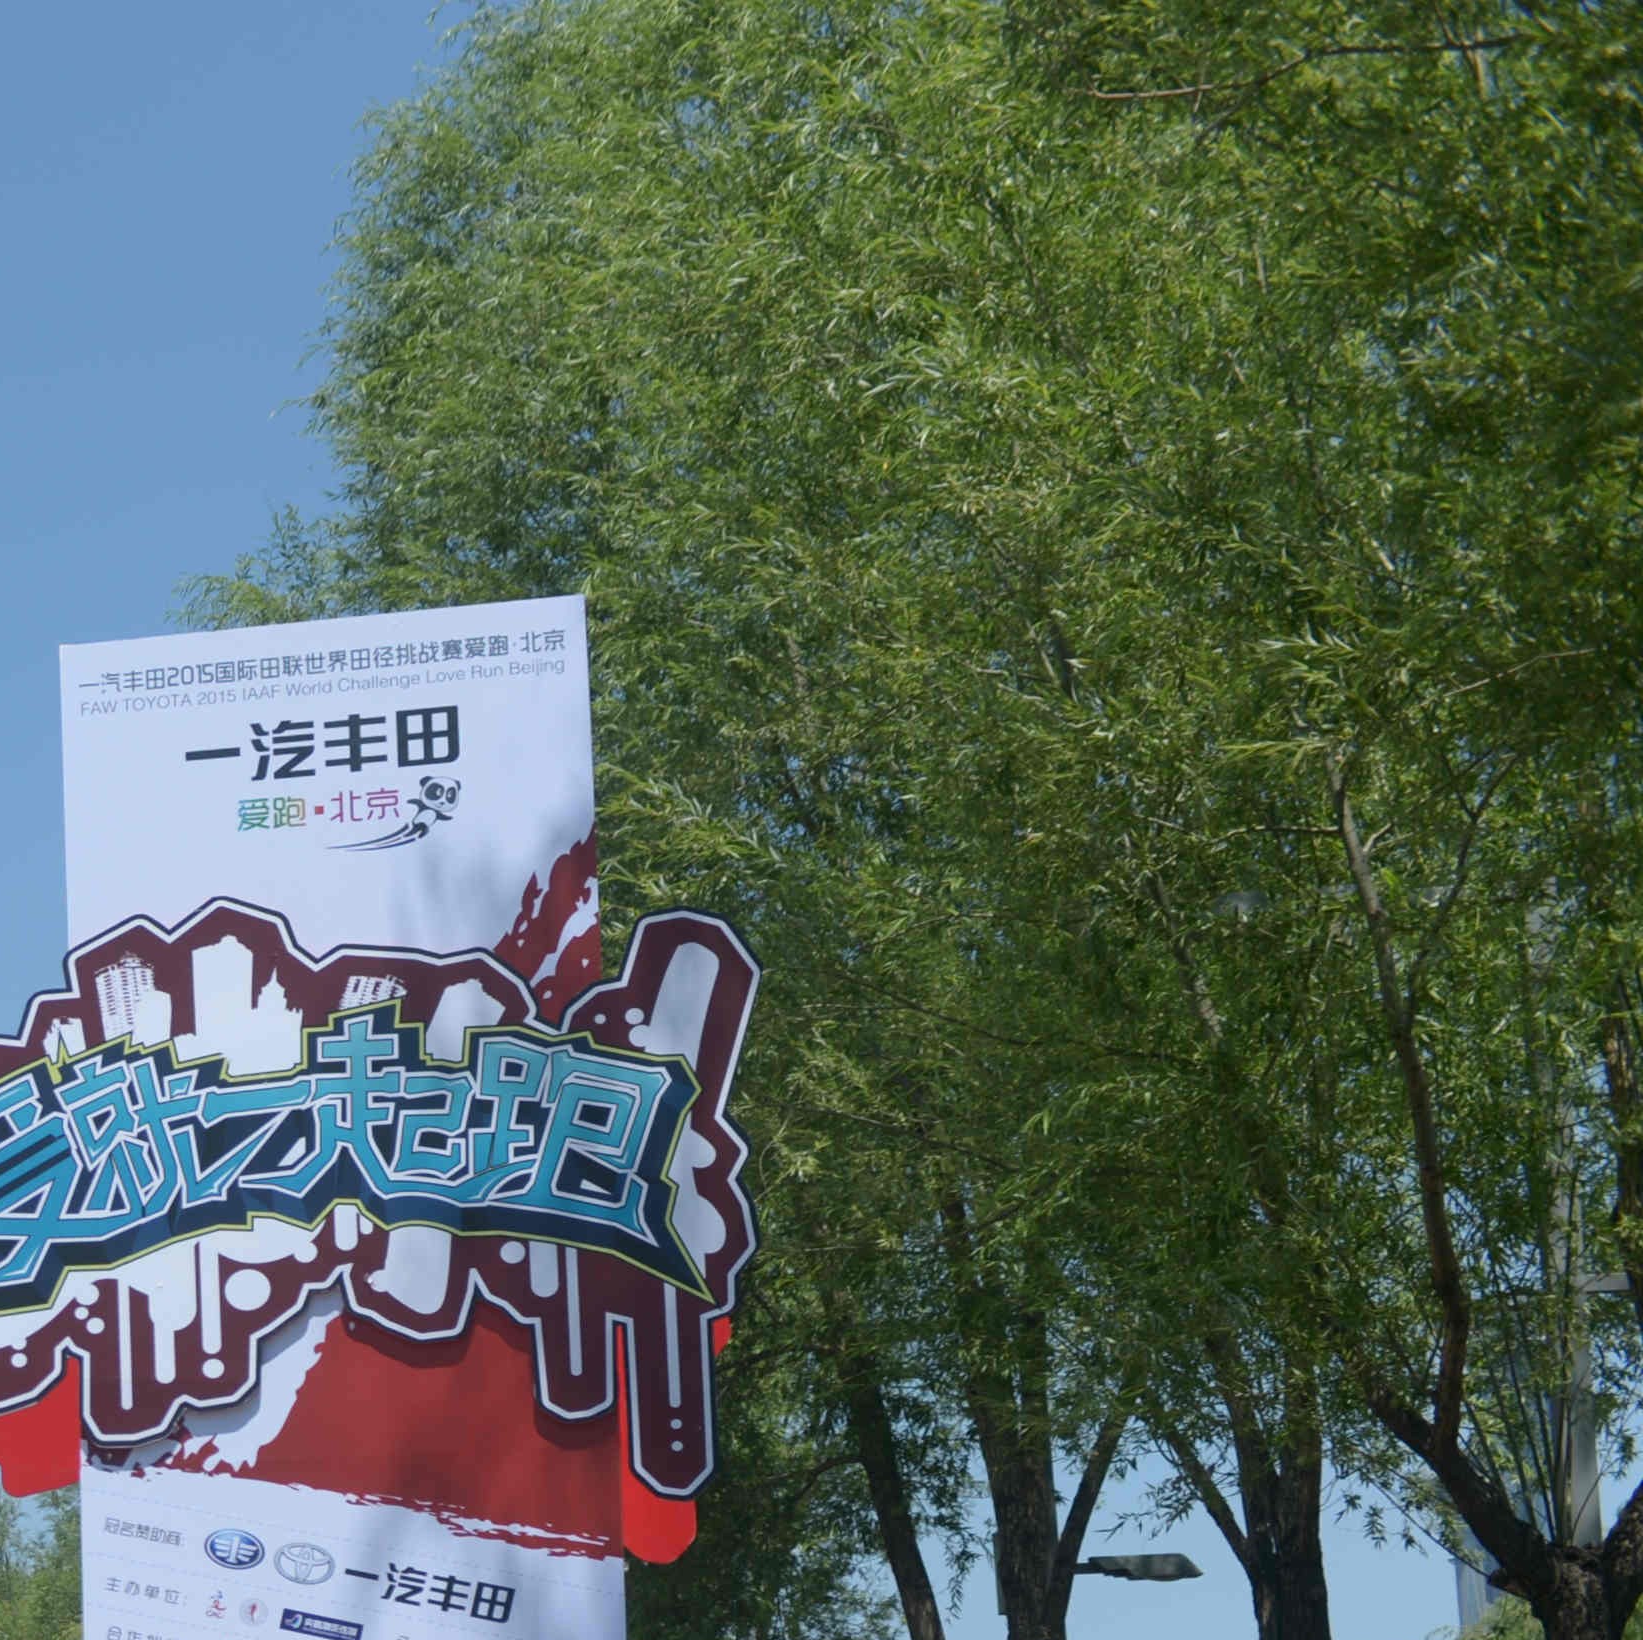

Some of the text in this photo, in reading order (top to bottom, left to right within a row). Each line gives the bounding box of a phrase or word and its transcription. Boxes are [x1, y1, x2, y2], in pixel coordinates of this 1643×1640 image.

[81, 658, 566, 717] FAW TOYOTA 2015 IAAF World Challenge Love Run Beijing
[184, 704, 461, 781] 一汽丰田
[344, 1562, 516, 1624] 一汽丰田
